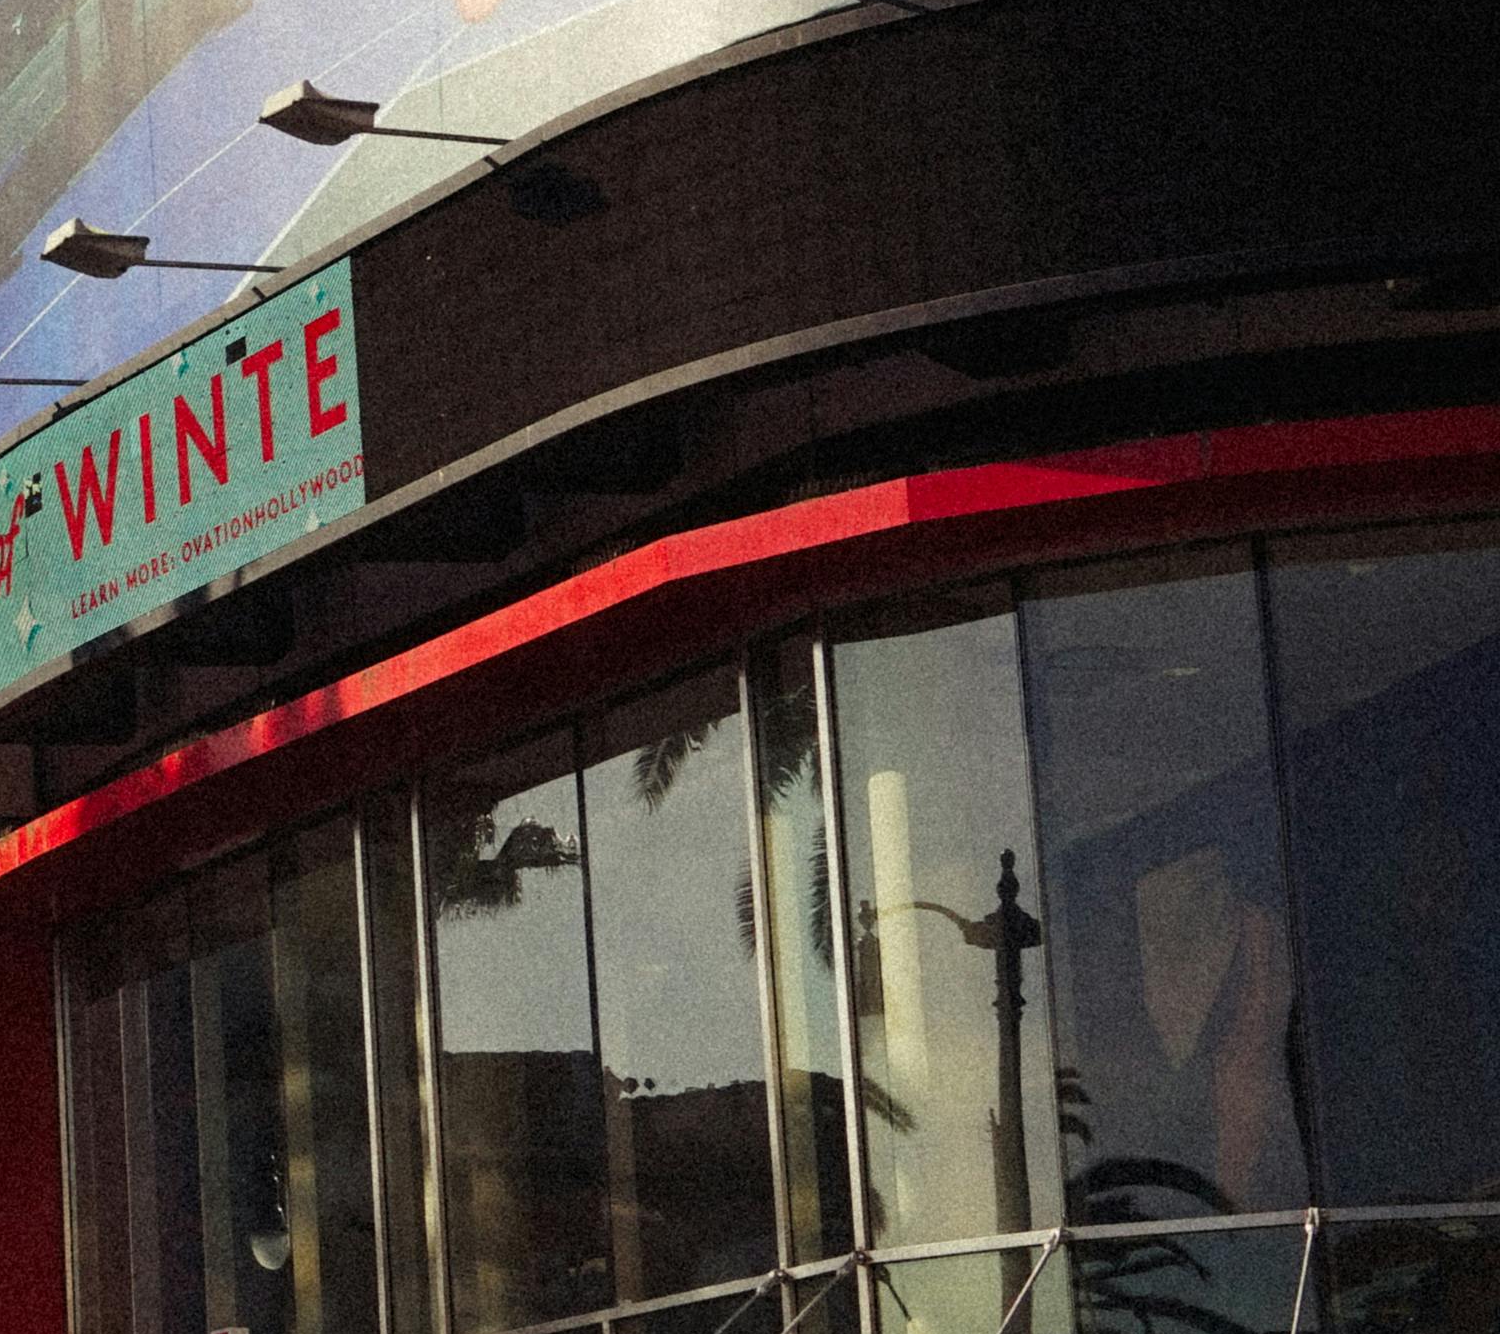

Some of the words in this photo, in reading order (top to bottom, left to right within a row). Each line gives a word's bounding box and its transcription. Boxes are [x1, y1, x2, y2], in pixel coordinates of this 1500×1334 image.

[53, 306, 348, 563] WINTE
[71, 577, 120, 620] LEARN
[126, 552, 176, 590] MORE:
